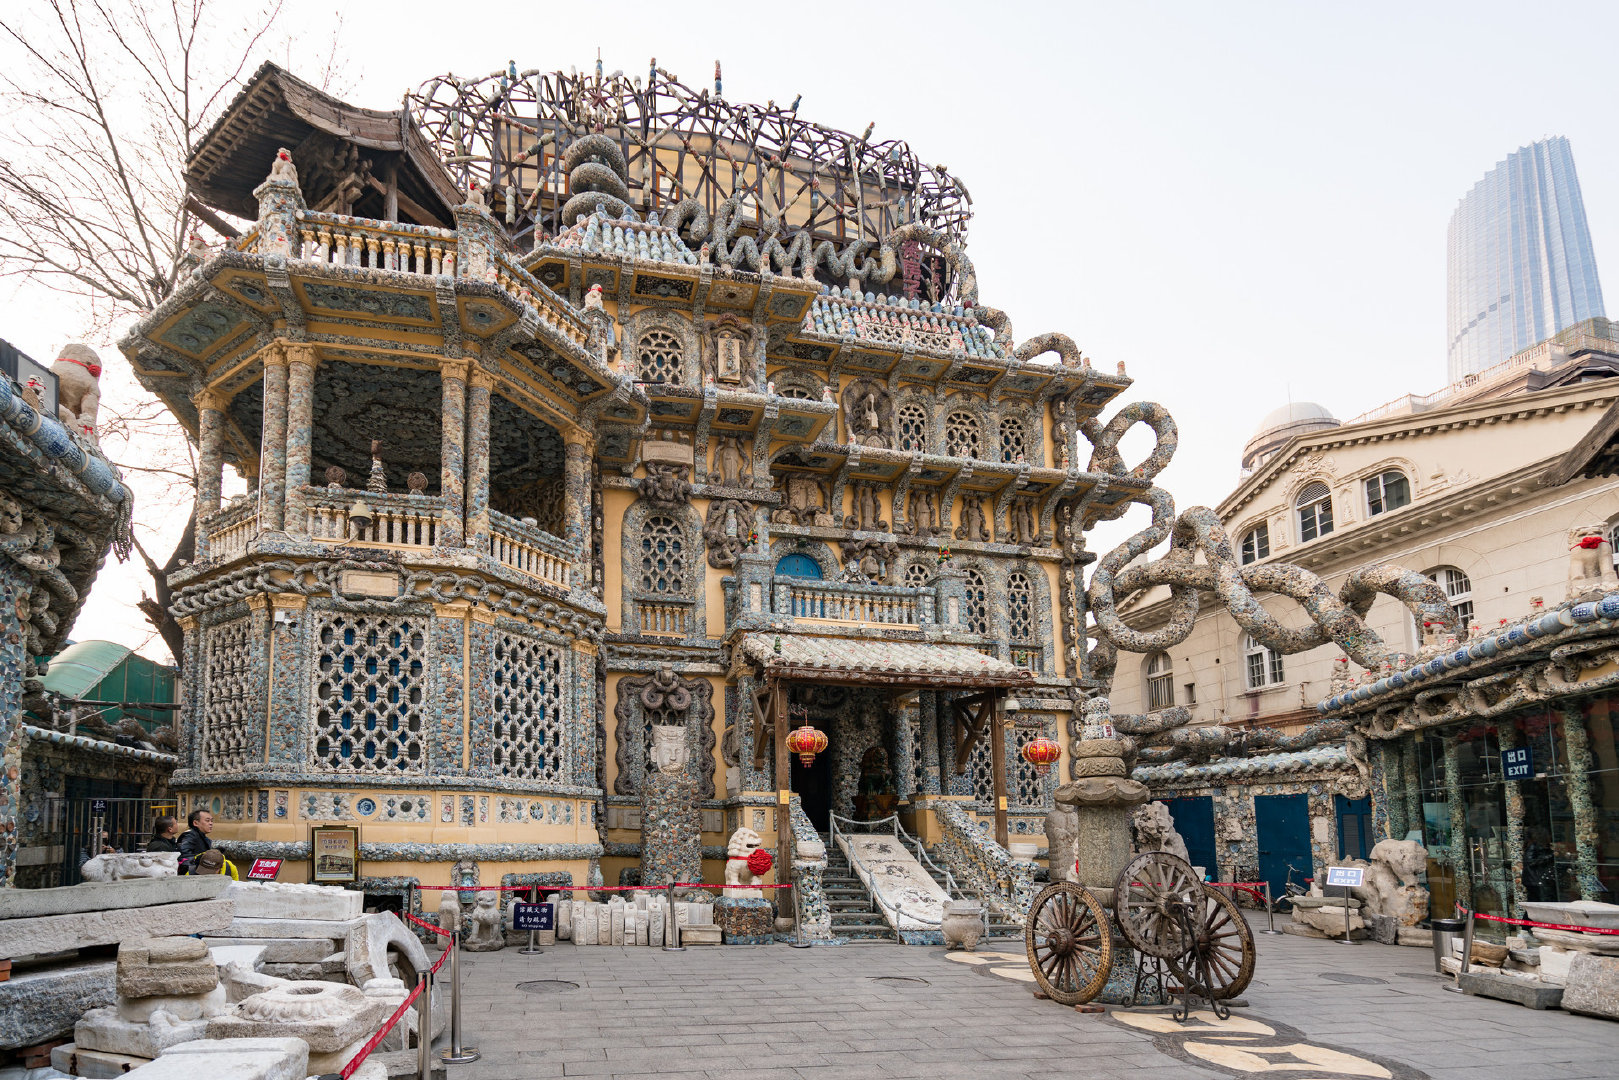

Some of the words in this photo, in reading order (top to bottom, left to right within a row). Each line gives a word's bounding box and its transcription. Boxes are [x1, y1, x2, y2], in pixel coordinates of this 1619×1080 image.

[1507, 749, 1527, 763] 出口
[1508, 765, 1528, 776] EXIT
[258, 860, 279, 868] 卫生间
